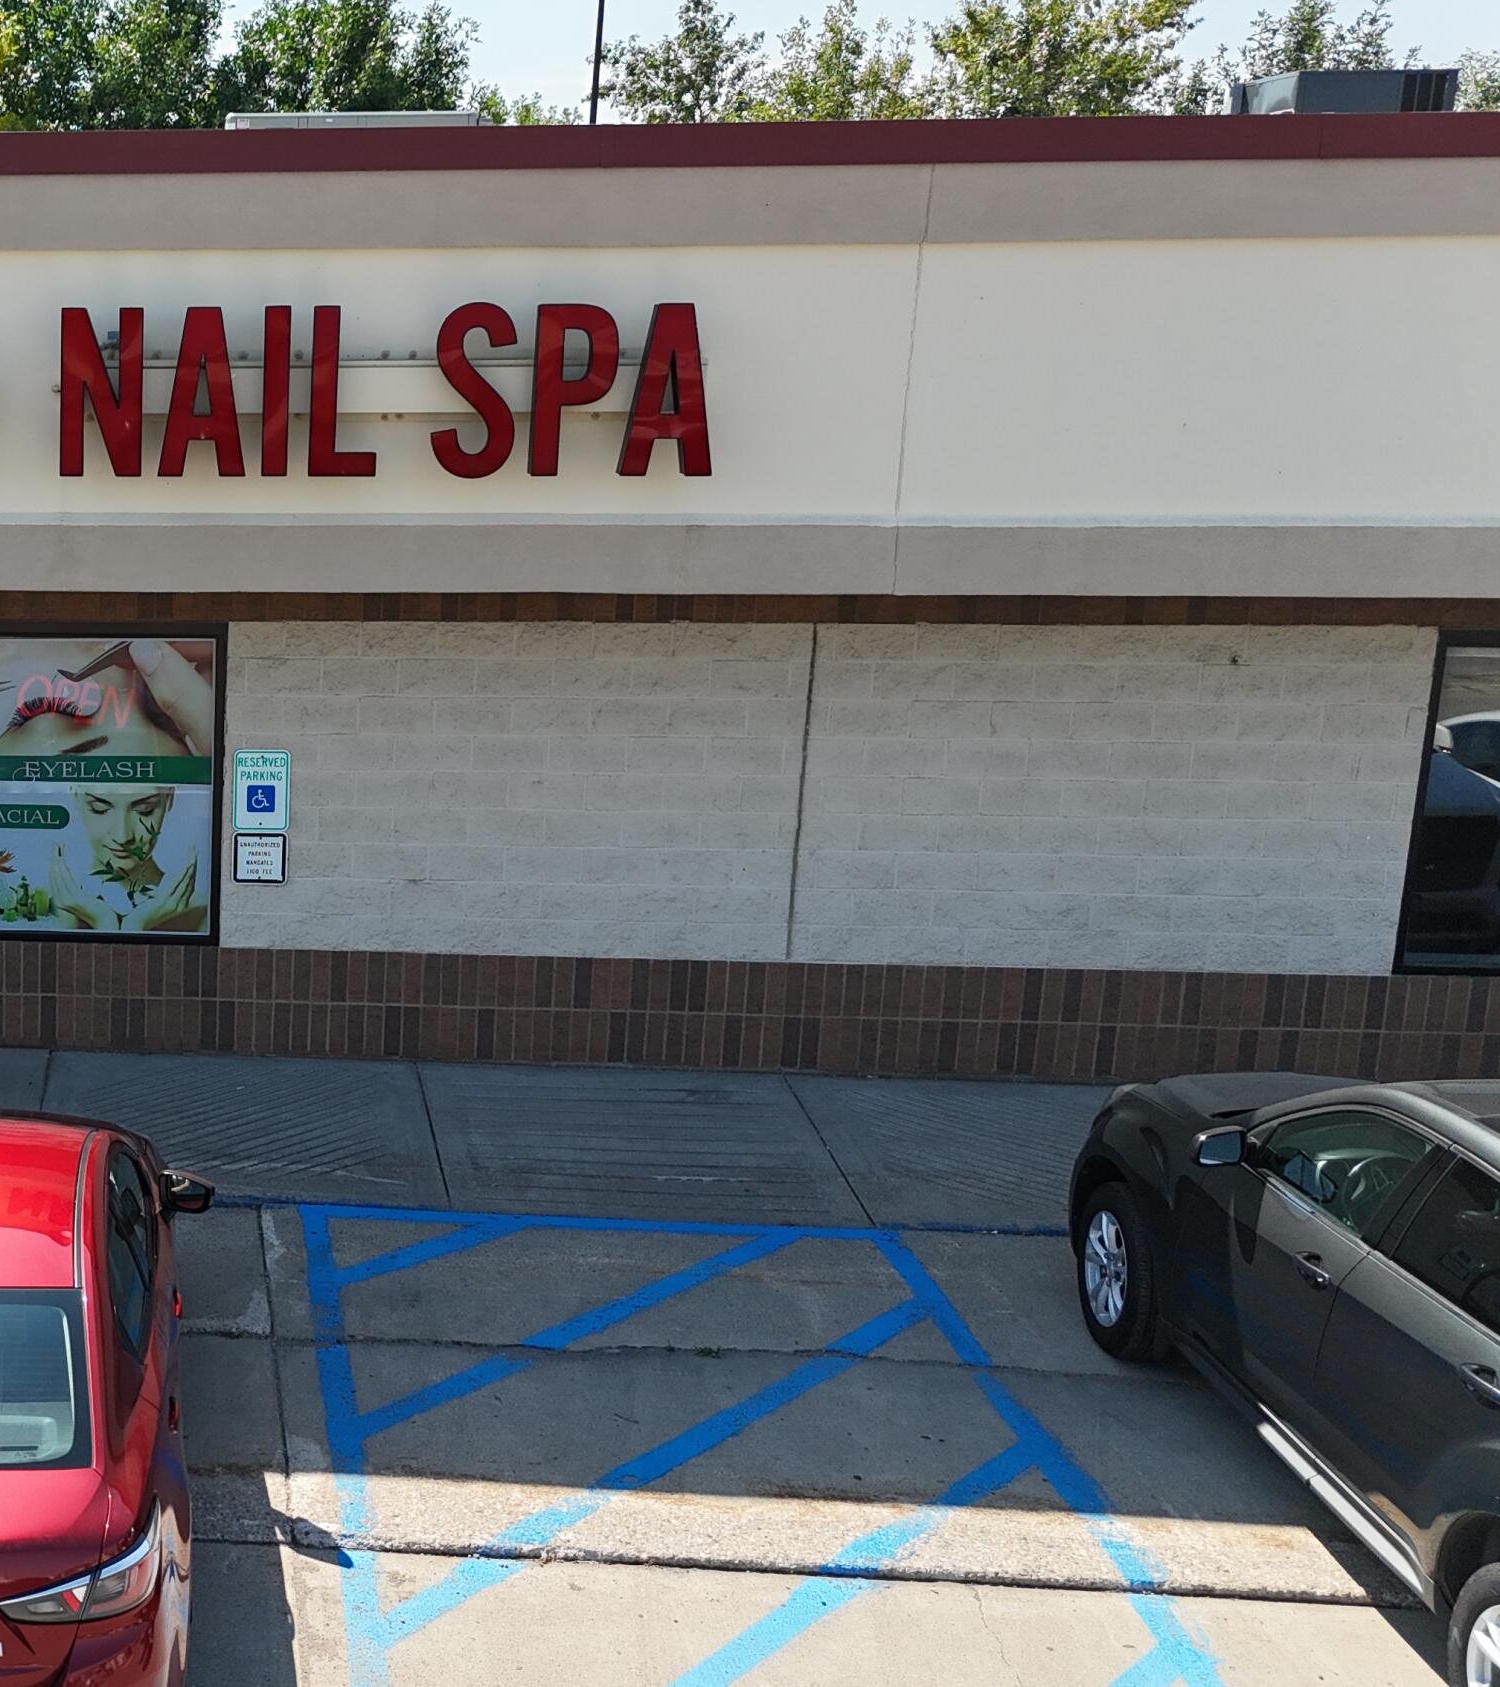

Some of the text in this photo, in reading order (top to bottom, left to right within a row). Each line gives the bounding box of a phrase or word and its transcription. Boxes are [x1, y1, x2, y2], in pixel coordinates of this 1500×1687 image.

[59, 305, 376, 478] NAIL
[430, 302, 712, 479] SPA
[17, 673, 137, 729] OPEN
[13, 761, 156, 783] EYELASH
[237, 757, 286, 768] RESERVED
[240, 771, 283, 781] PARKING
